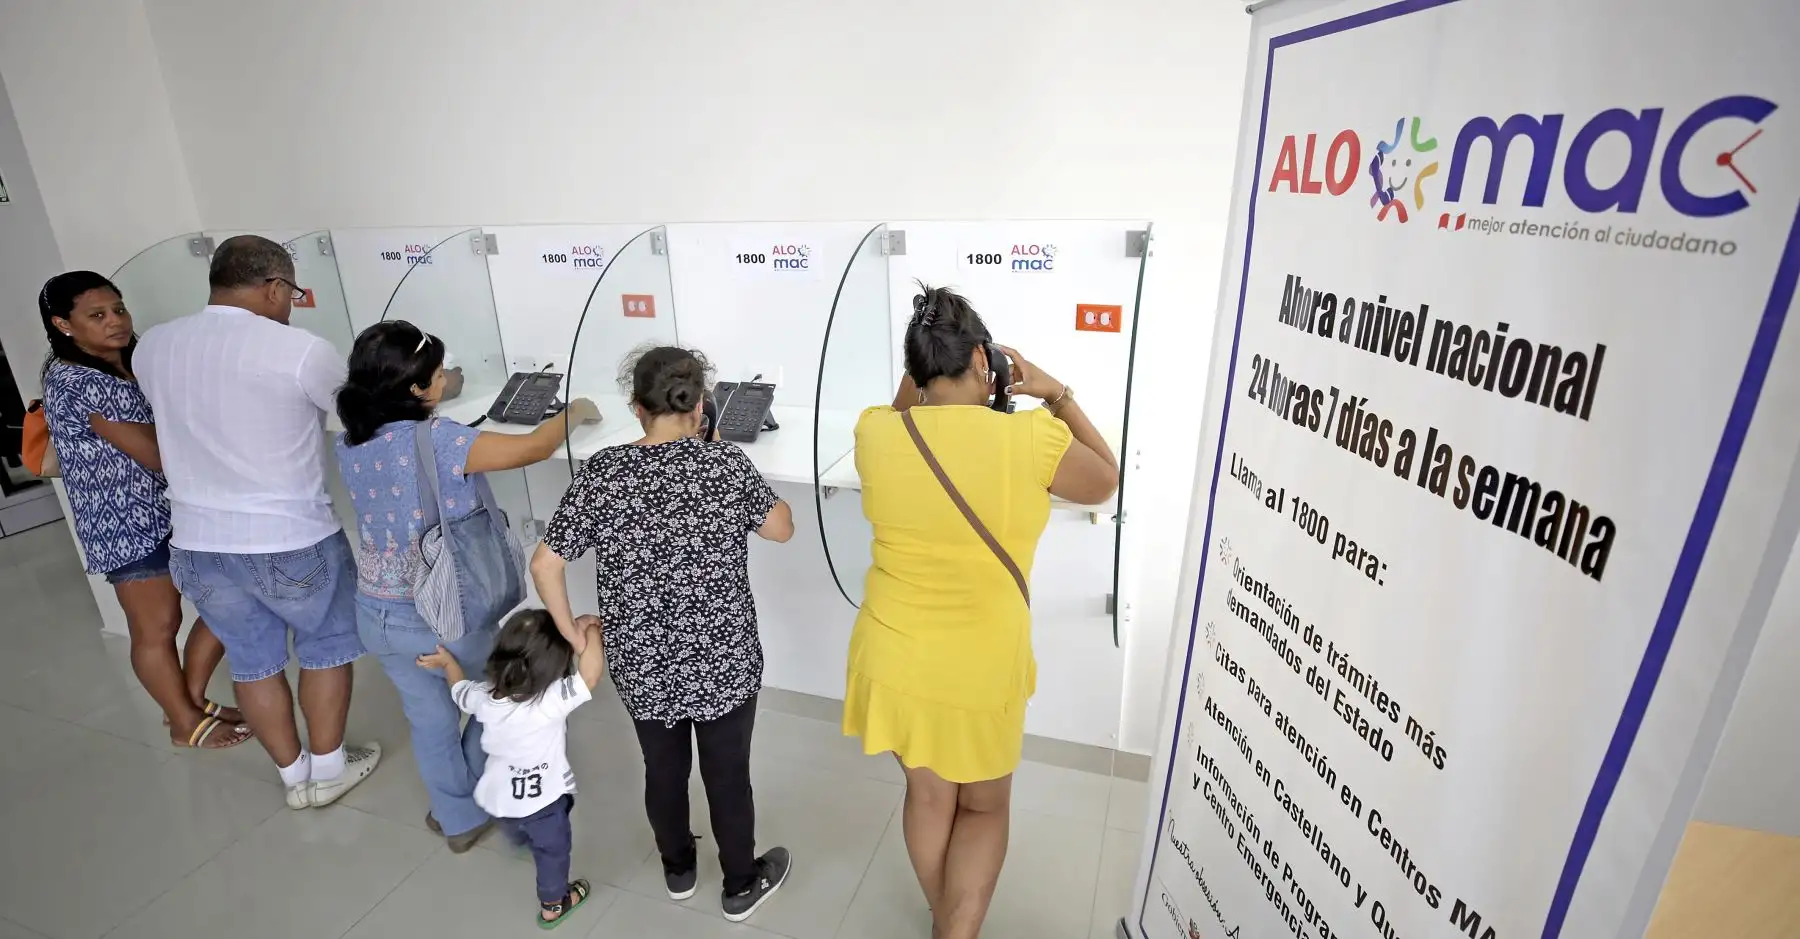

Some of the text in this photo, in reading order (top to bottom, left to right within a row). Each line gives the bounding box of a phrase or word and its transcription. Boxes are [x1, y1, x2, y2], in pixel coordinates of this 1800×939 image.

[1268, 94, 1779, 218] ALO mac
[1468, 214, 1738, 258] mejor atención al ciudadano
[381, 251, 402, 262] 1800
[404, 244, 422, 254] ALO
[542, 253, 567, 264] 1800
[571, 246, 592, 256] ALO
[736, 253, 766, 264] 1800
[772, 244, 796, 256] ALO
[966, 253, 1002, 265] 1800
[1011, 244, 1040, 256] ALO
[406, 255, 433, 265] mac
[573, 256, 604, 268] mac
[773, 256, 809, 269] mac
[1011, 256, 1054, 271] mac
[1279, 273, 1607, 423] Ahora a nivel nacional
[1247, 352, 1618, 583] 24 horas 7 días a la semana
[1230, 452, 1389, 587] Llama al 1800 para:
[1231, 557, 1448, 771] Orientación de trámites más
[1226, 588, 1395, 763] demandados del Estado
[511, 773, 542, 800] 03
[1215, 641, 1247, 685] Citas
[1247, 676, 1272, 718] para
[1274, 710, 1338, 791] atención
[1340, 784, 1364, 819] en
[1366, 808, 1443, 911] Centros
[1192, 771, 1202, 791] y
[1203, 781, 1236, 840] Centro
[1204, 696, 1402, 939] Atención en Castellano y Qu
[1196, 744, 1339, 939] Información de Progra
